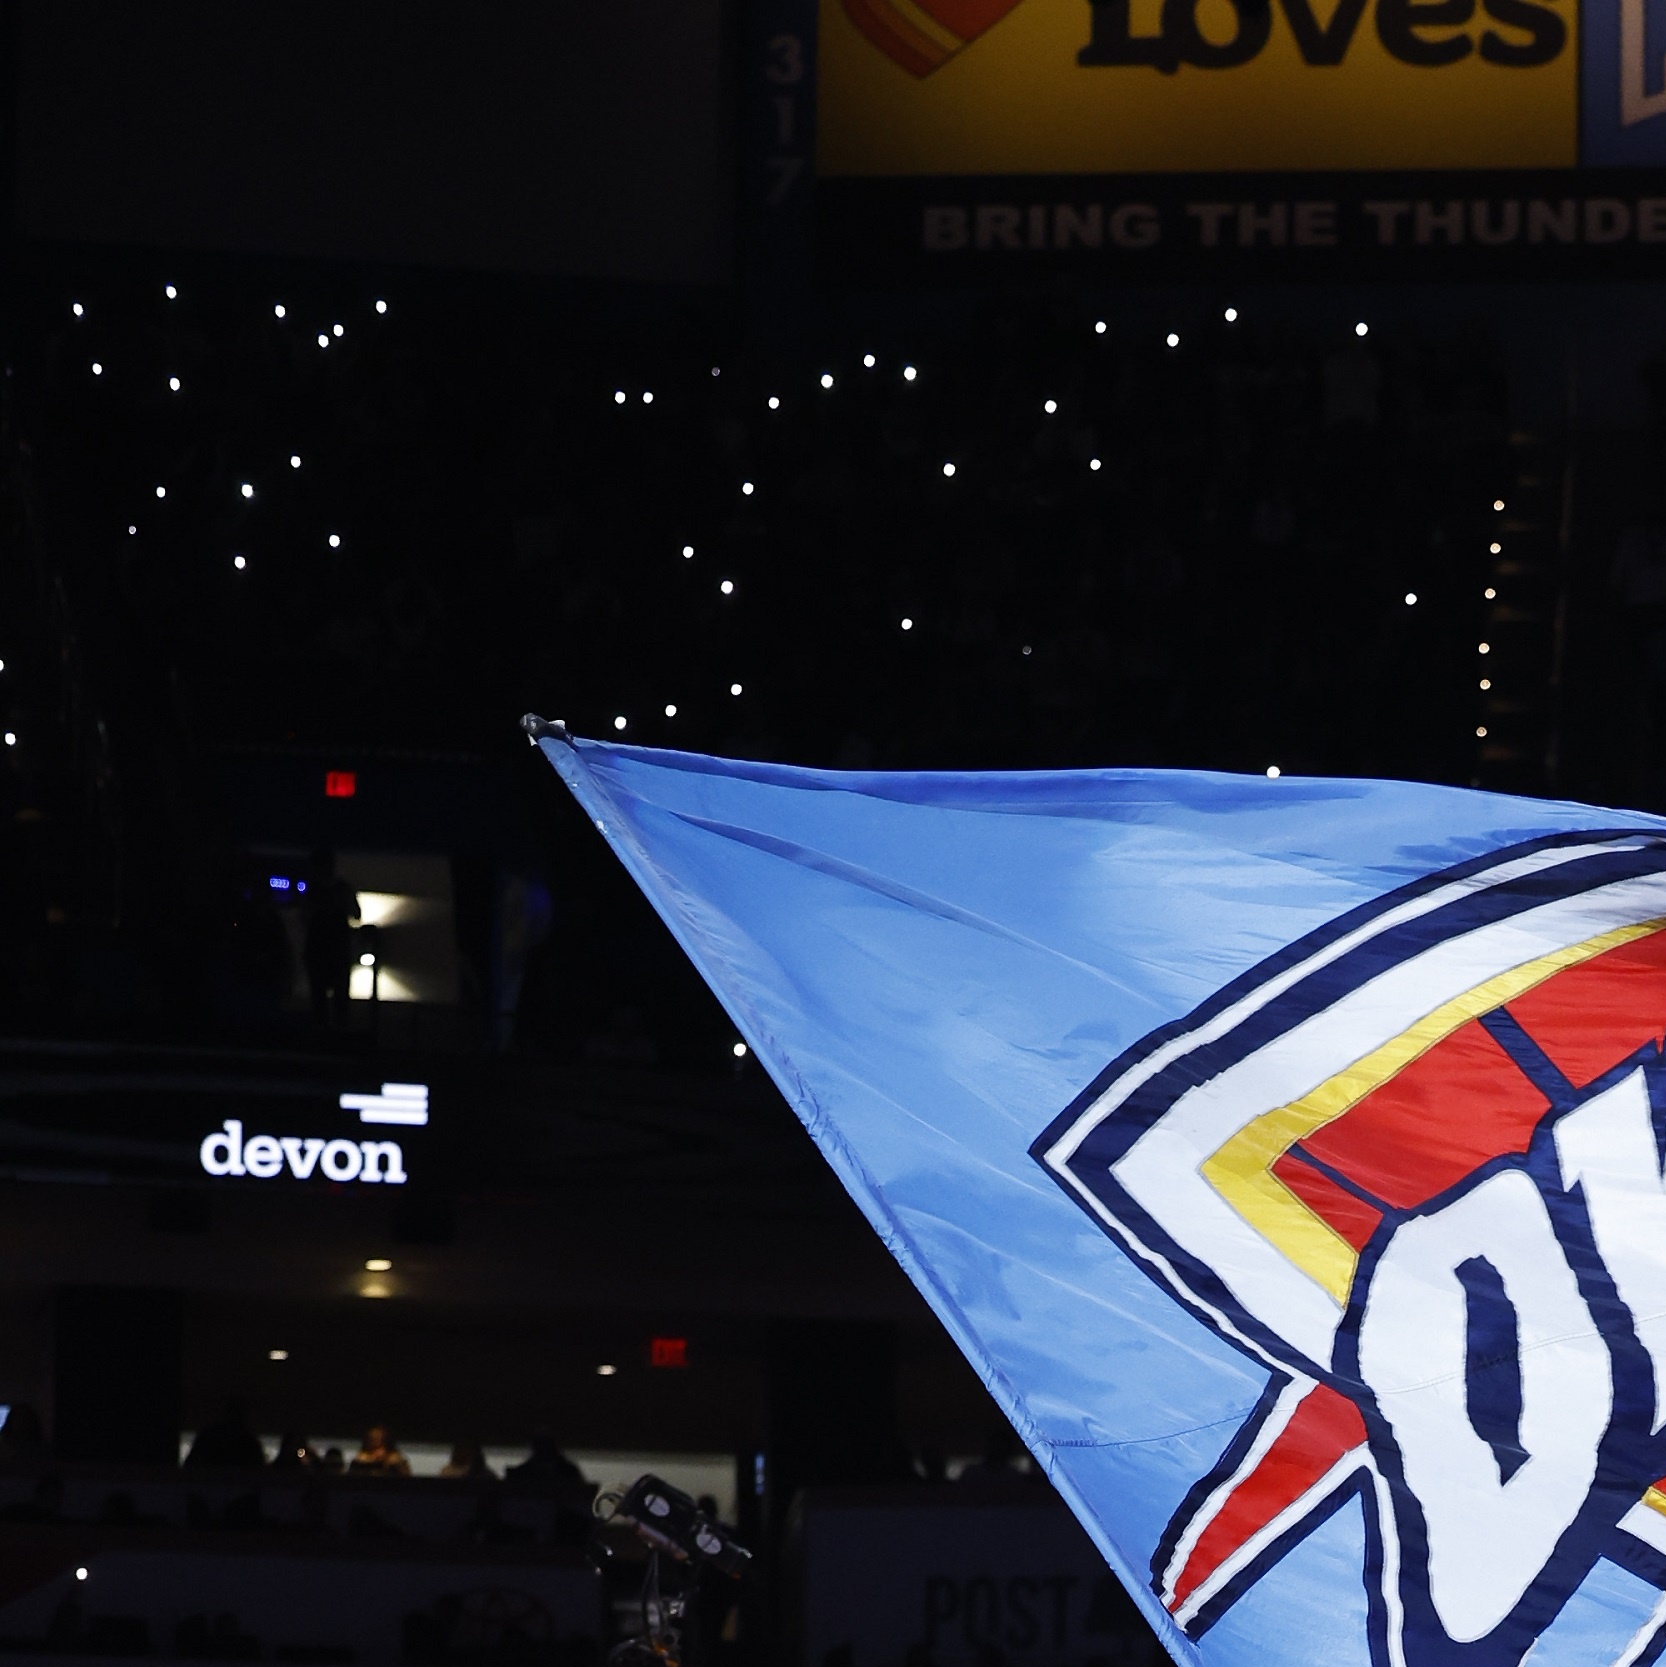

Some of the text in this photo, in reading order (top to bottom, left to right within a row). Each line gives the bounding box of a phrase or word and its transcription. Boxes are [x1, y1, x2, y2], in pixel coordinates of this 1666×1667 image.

[921, 203, 1162, 252] BRING
[1182, 202, 1338, 248] THE
[200, 1118, 408, 1184] devon
